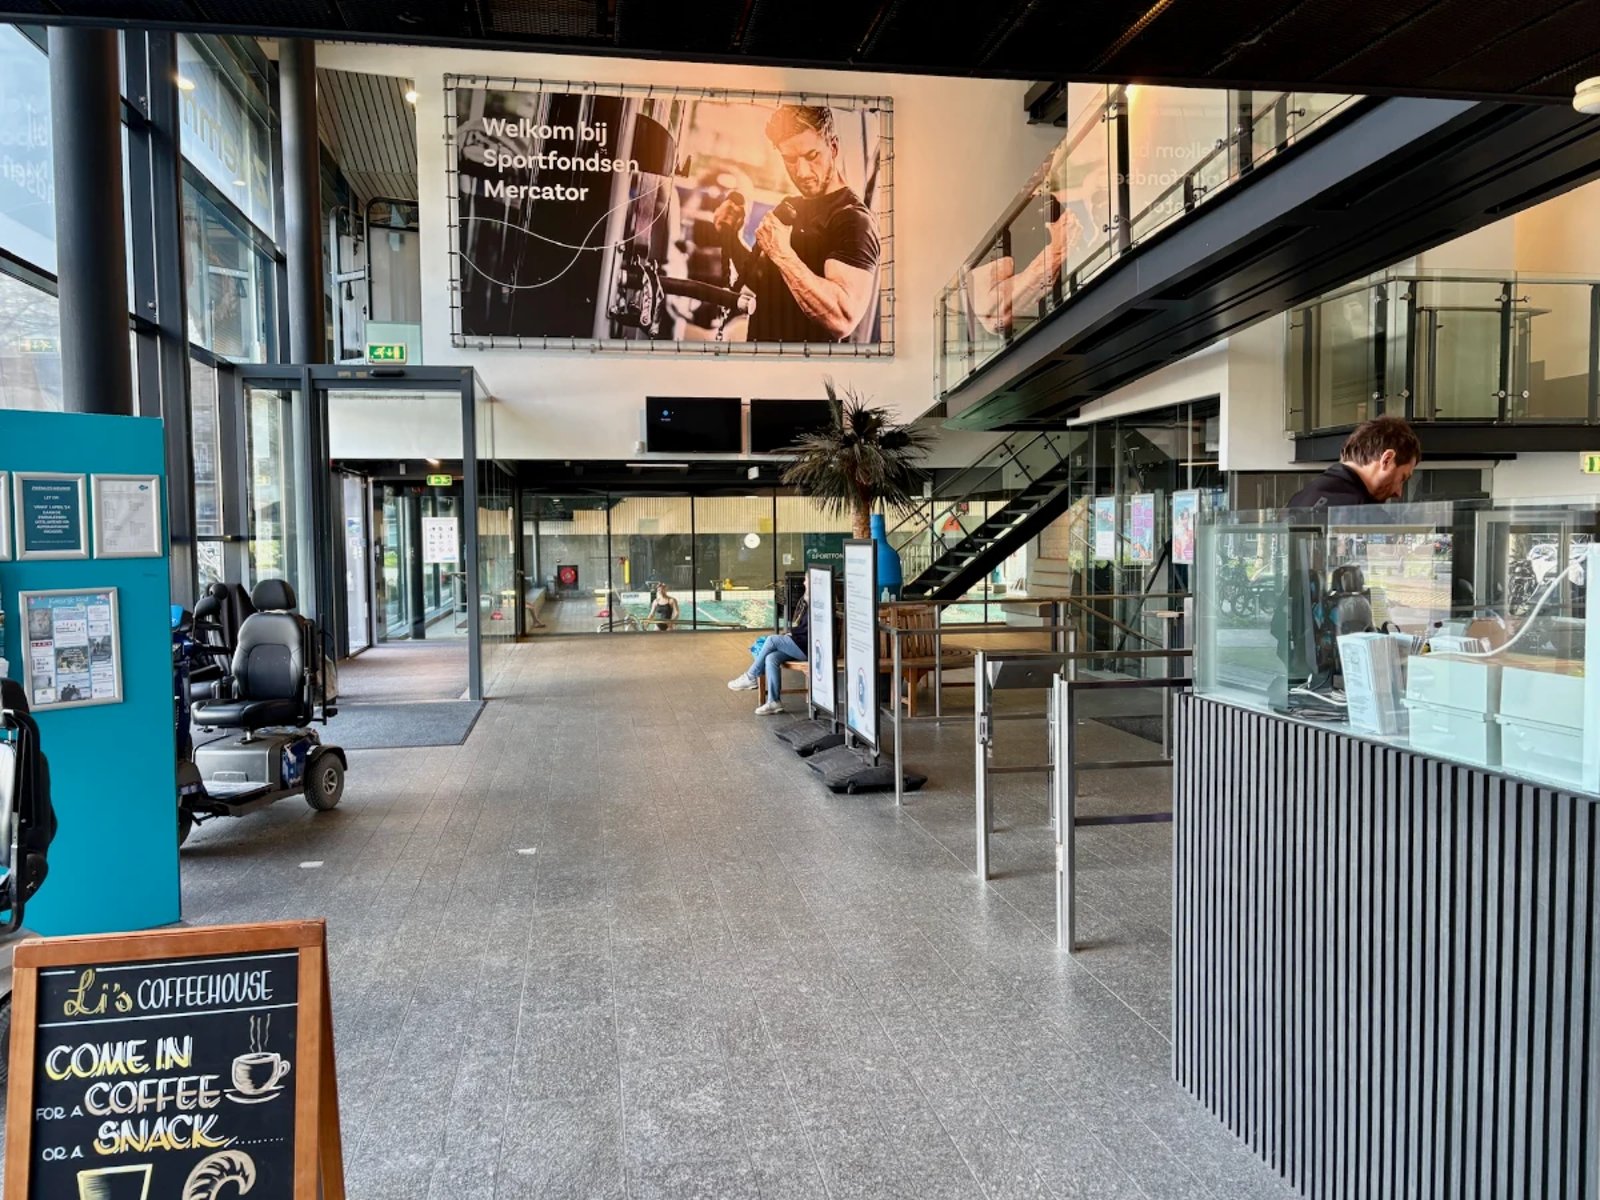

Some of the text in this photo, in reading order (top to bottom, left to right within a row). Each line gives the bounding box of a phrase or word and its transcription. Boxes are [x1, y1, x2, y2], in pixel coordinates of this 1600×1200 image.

[482, 117, 608, 147] Welkom bij
[483, 149, 640, 173] Sportfondsen
[484, 179, 589, 201] Mercator
[63, 968, 274, 1017] Li's COFFEEHOUSE
[45, 1035, 193, 1081] COME IN
[36, 1074, 221, 1121] FOR A COFFEE
[42, 1147, 68, 1161] OR
[70, 1146, 84, 1159] A
